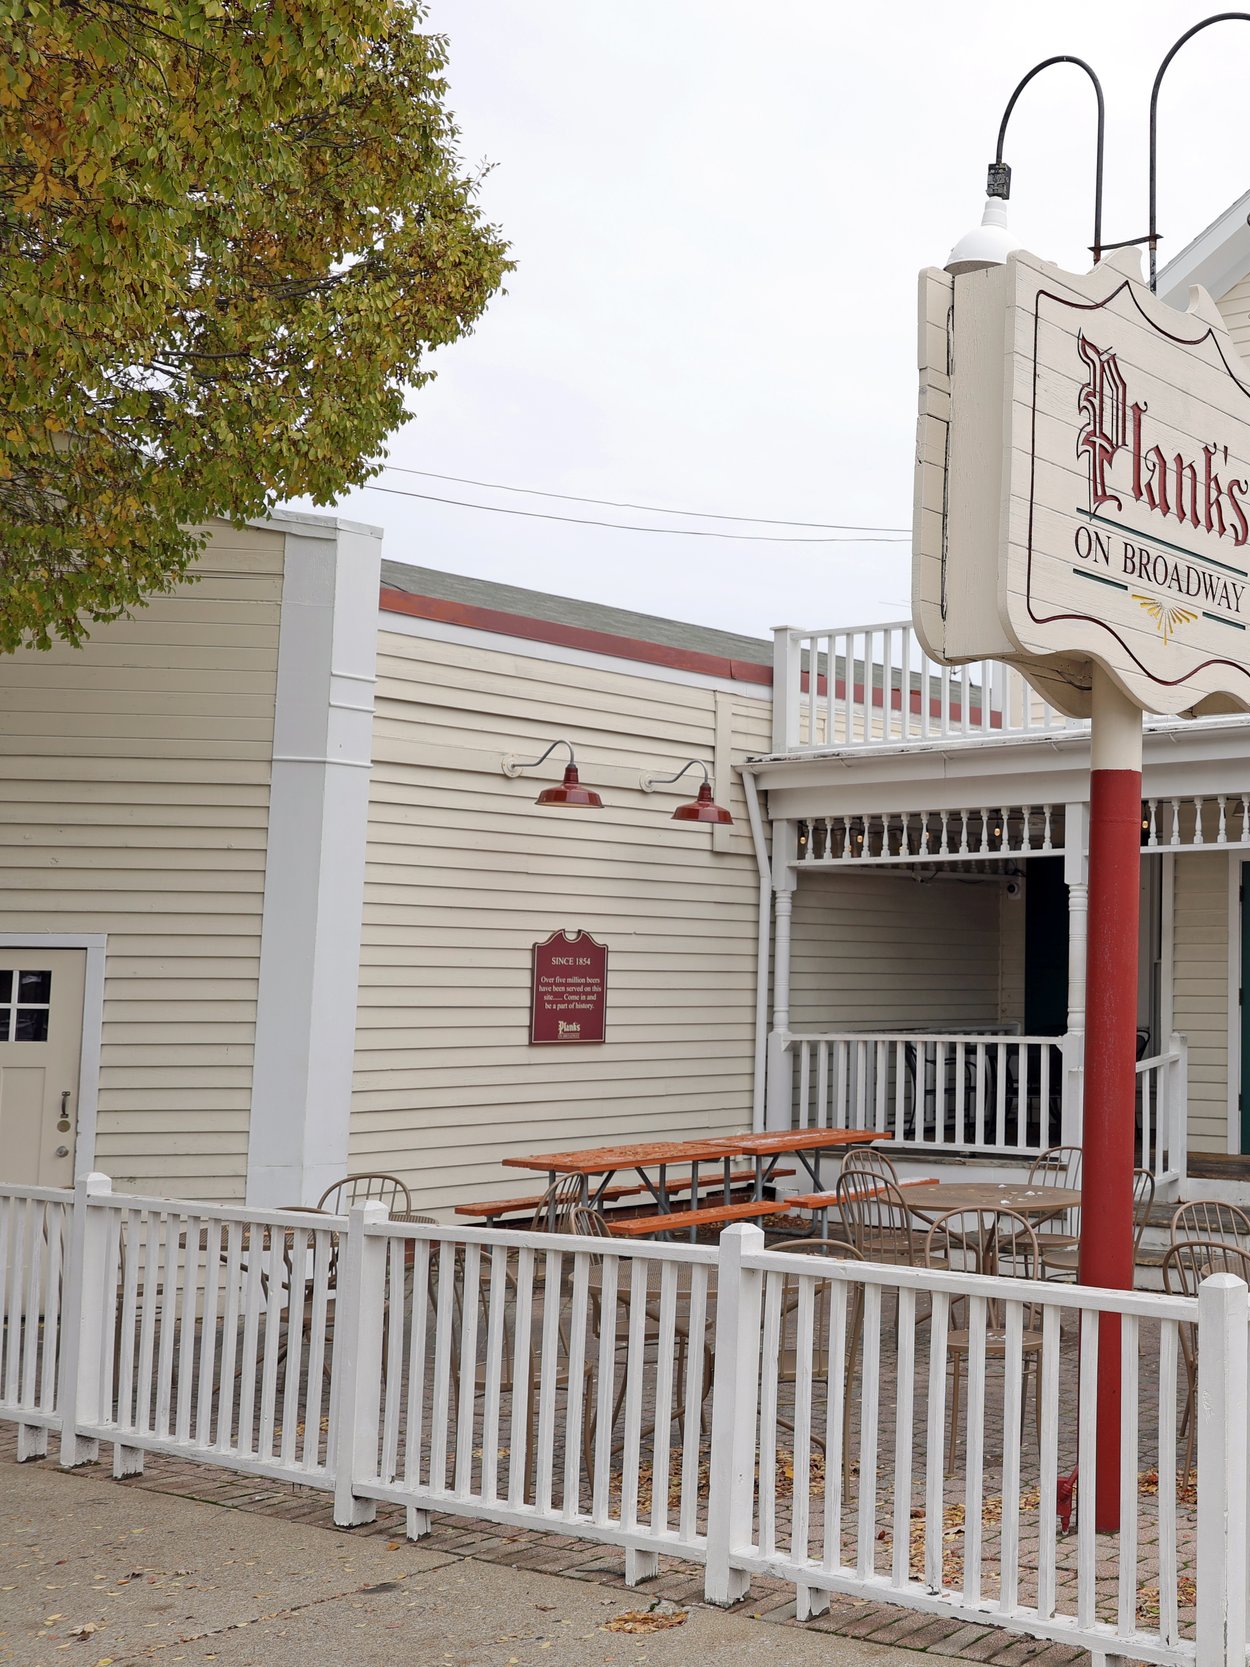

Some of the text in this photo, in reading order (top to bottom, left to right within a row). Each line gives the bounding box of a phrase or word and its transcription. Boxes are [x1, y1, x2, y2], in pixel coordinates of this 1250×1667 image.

[1076, 326, 1249, 547] Plank's
[1074, 525, 1246, 614] ON BROADWAY
[576, 957, 591, 965] 1854
[575, 1002, 594, 1011] history.
